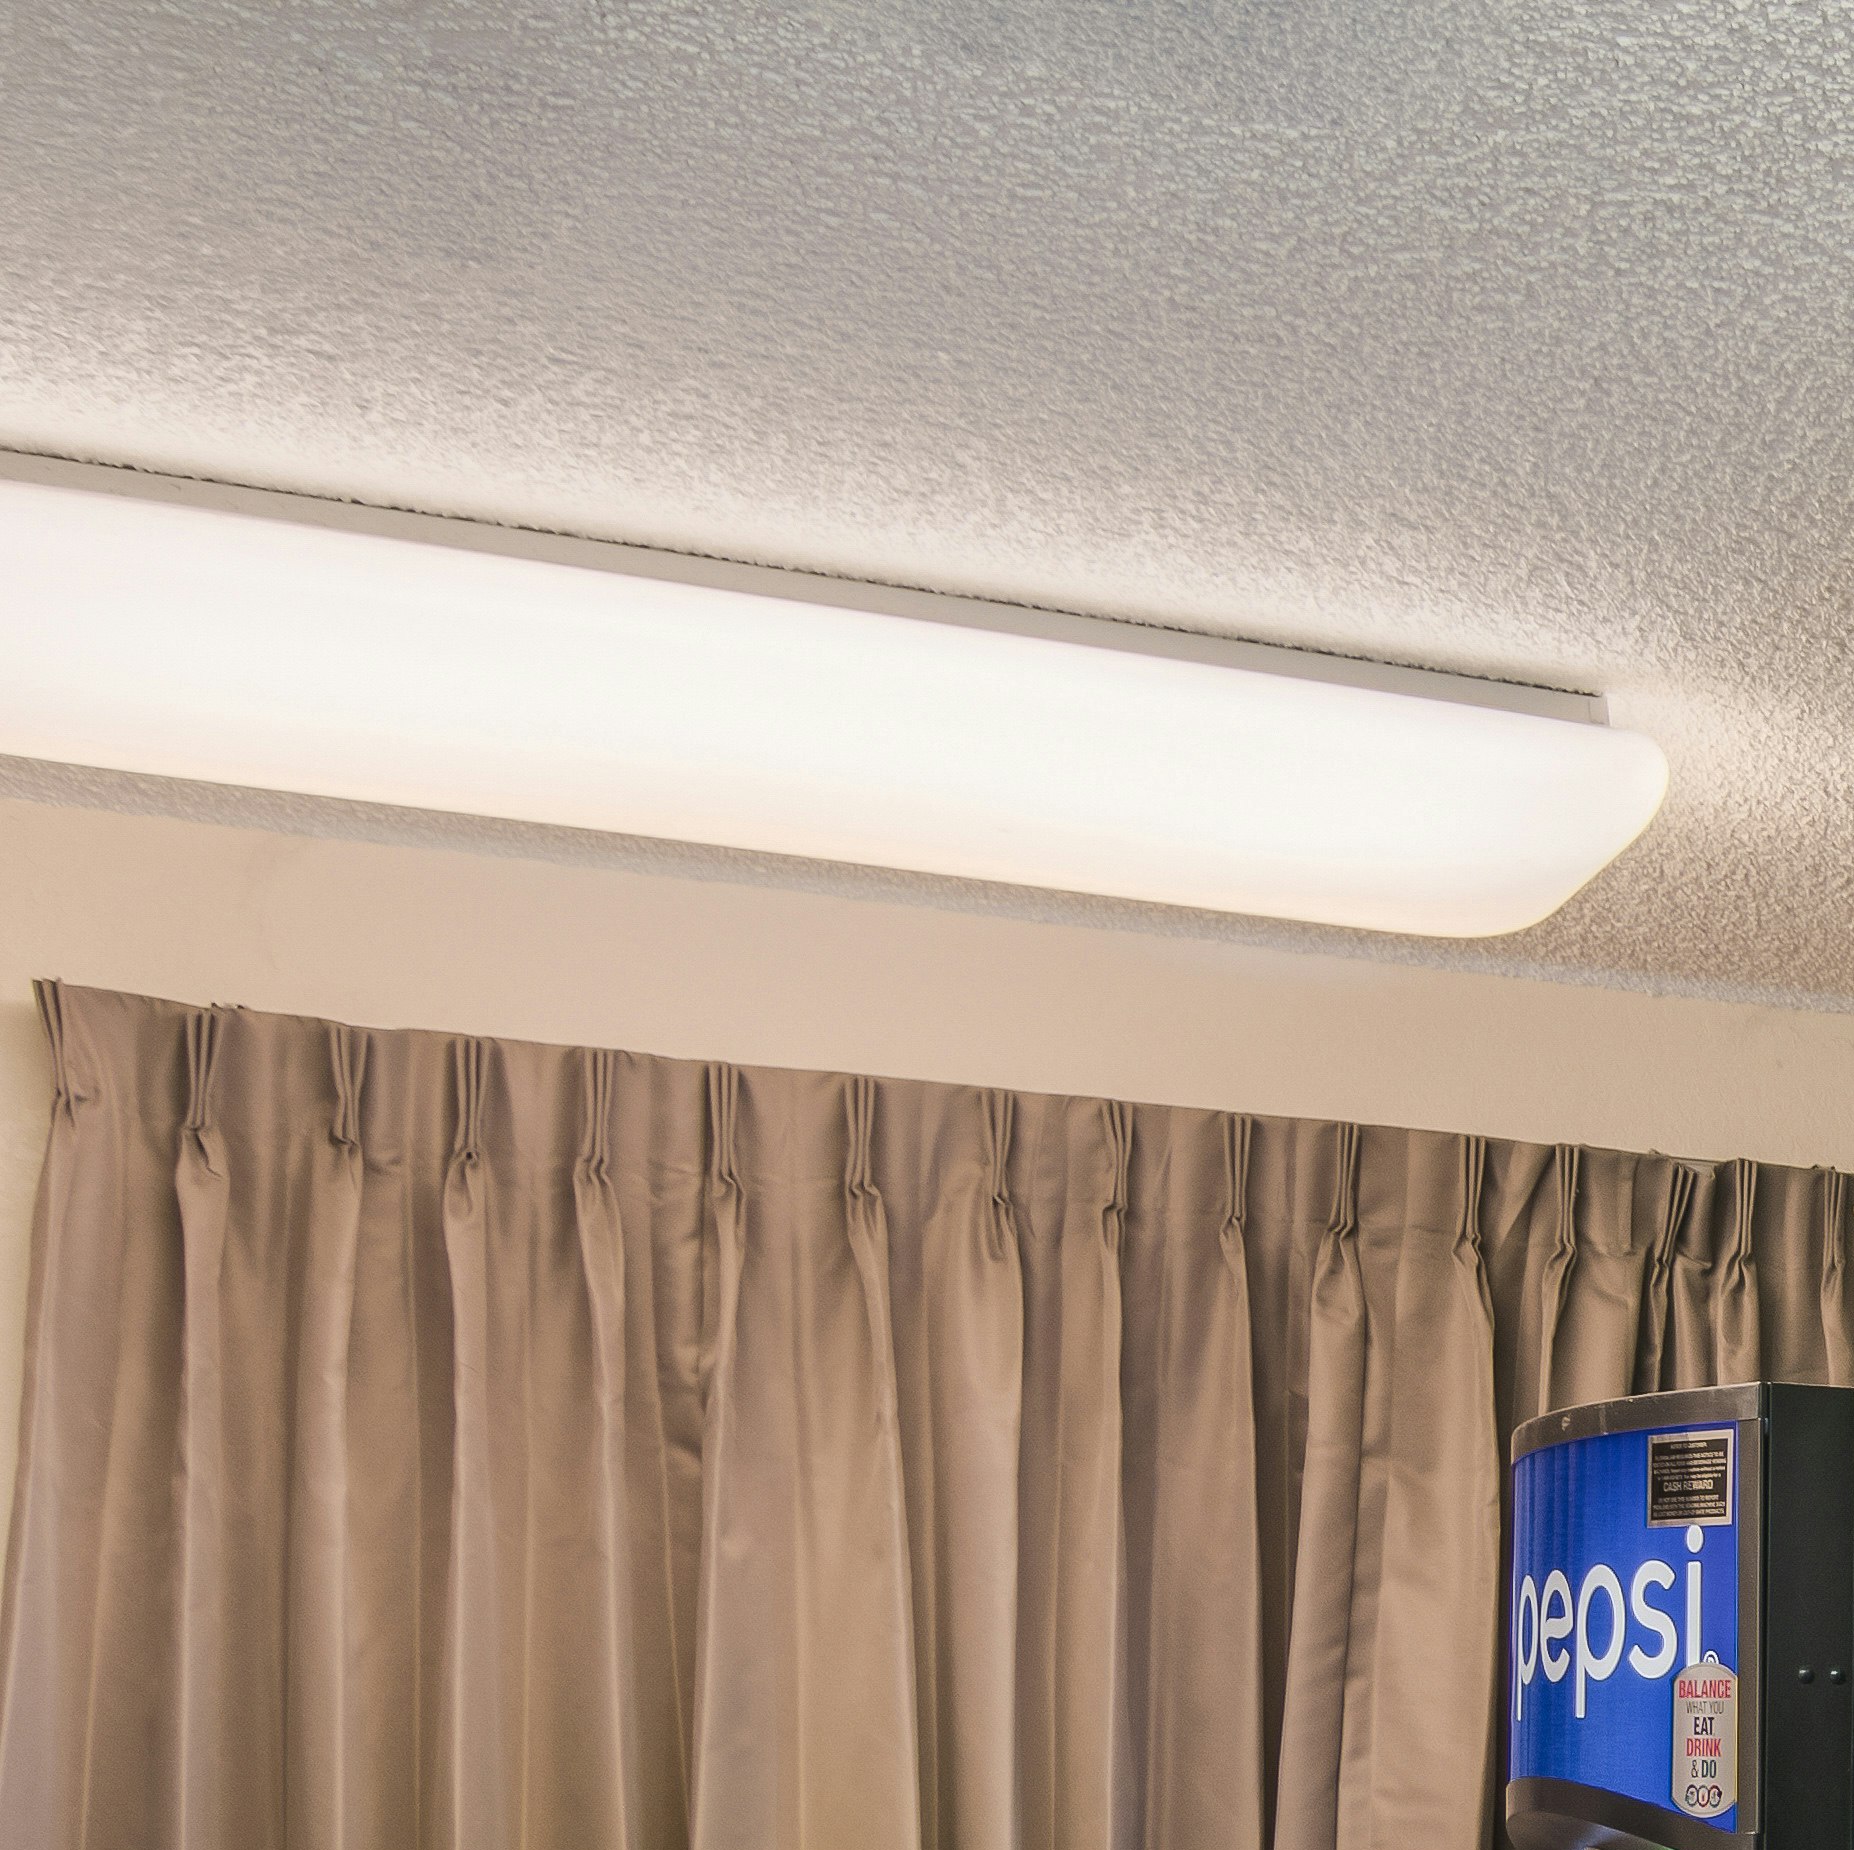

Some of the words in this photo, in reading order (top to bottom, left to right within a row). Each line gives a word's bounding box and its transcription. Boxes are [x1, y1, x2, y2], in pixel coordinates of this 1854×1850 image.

[1516, 1524, 1704, 1722] pepsi
[1678, 1680, 1732, 1698] BALANCE
[1686, 1701, 1709, 1714] WHAT
[1709, 1701, 1724, 1714] YOU
[1694, 1717, 1715, 1736] EAT
[1686, 1738, 1722, 1757] DRINK
[1691, 1760, 1698, 1778] &
[1702, 1760, 1717, 1778] DO
